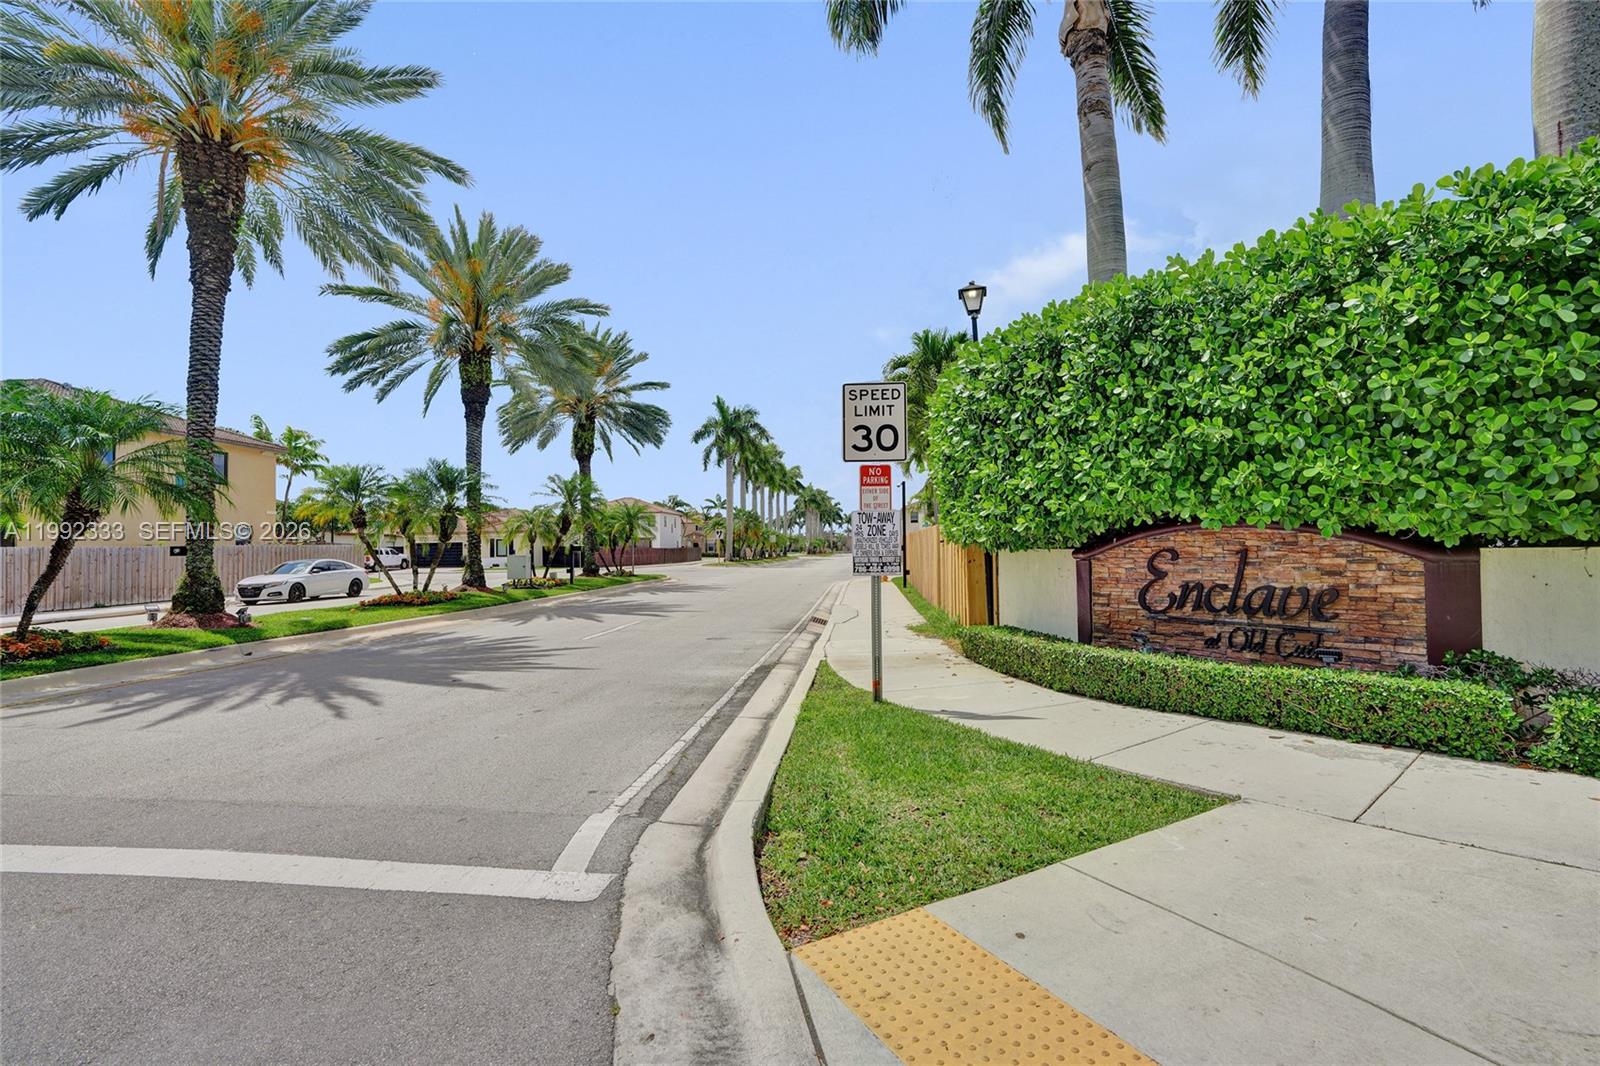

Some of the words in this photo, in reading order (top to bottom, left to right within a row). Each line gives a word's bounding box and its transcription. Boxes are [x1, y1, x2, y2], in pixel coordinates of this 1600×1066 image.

[848, 388, 901, 401] SPEED
[854, 404, 895, 417] LIMIT
[851, 424, 899, 452] 30
[868, 467, 882, 476] NO
[862, 476, 889, 484] PARKING
[857, 512, 895, 524] TOW-AWAY
[867, 524, 886, 537] ZONE
[1137, 547, 1340, 621] Enclave
[1203, 632, 1221, 649] at
[1228, 626, 1268, 653] Old
